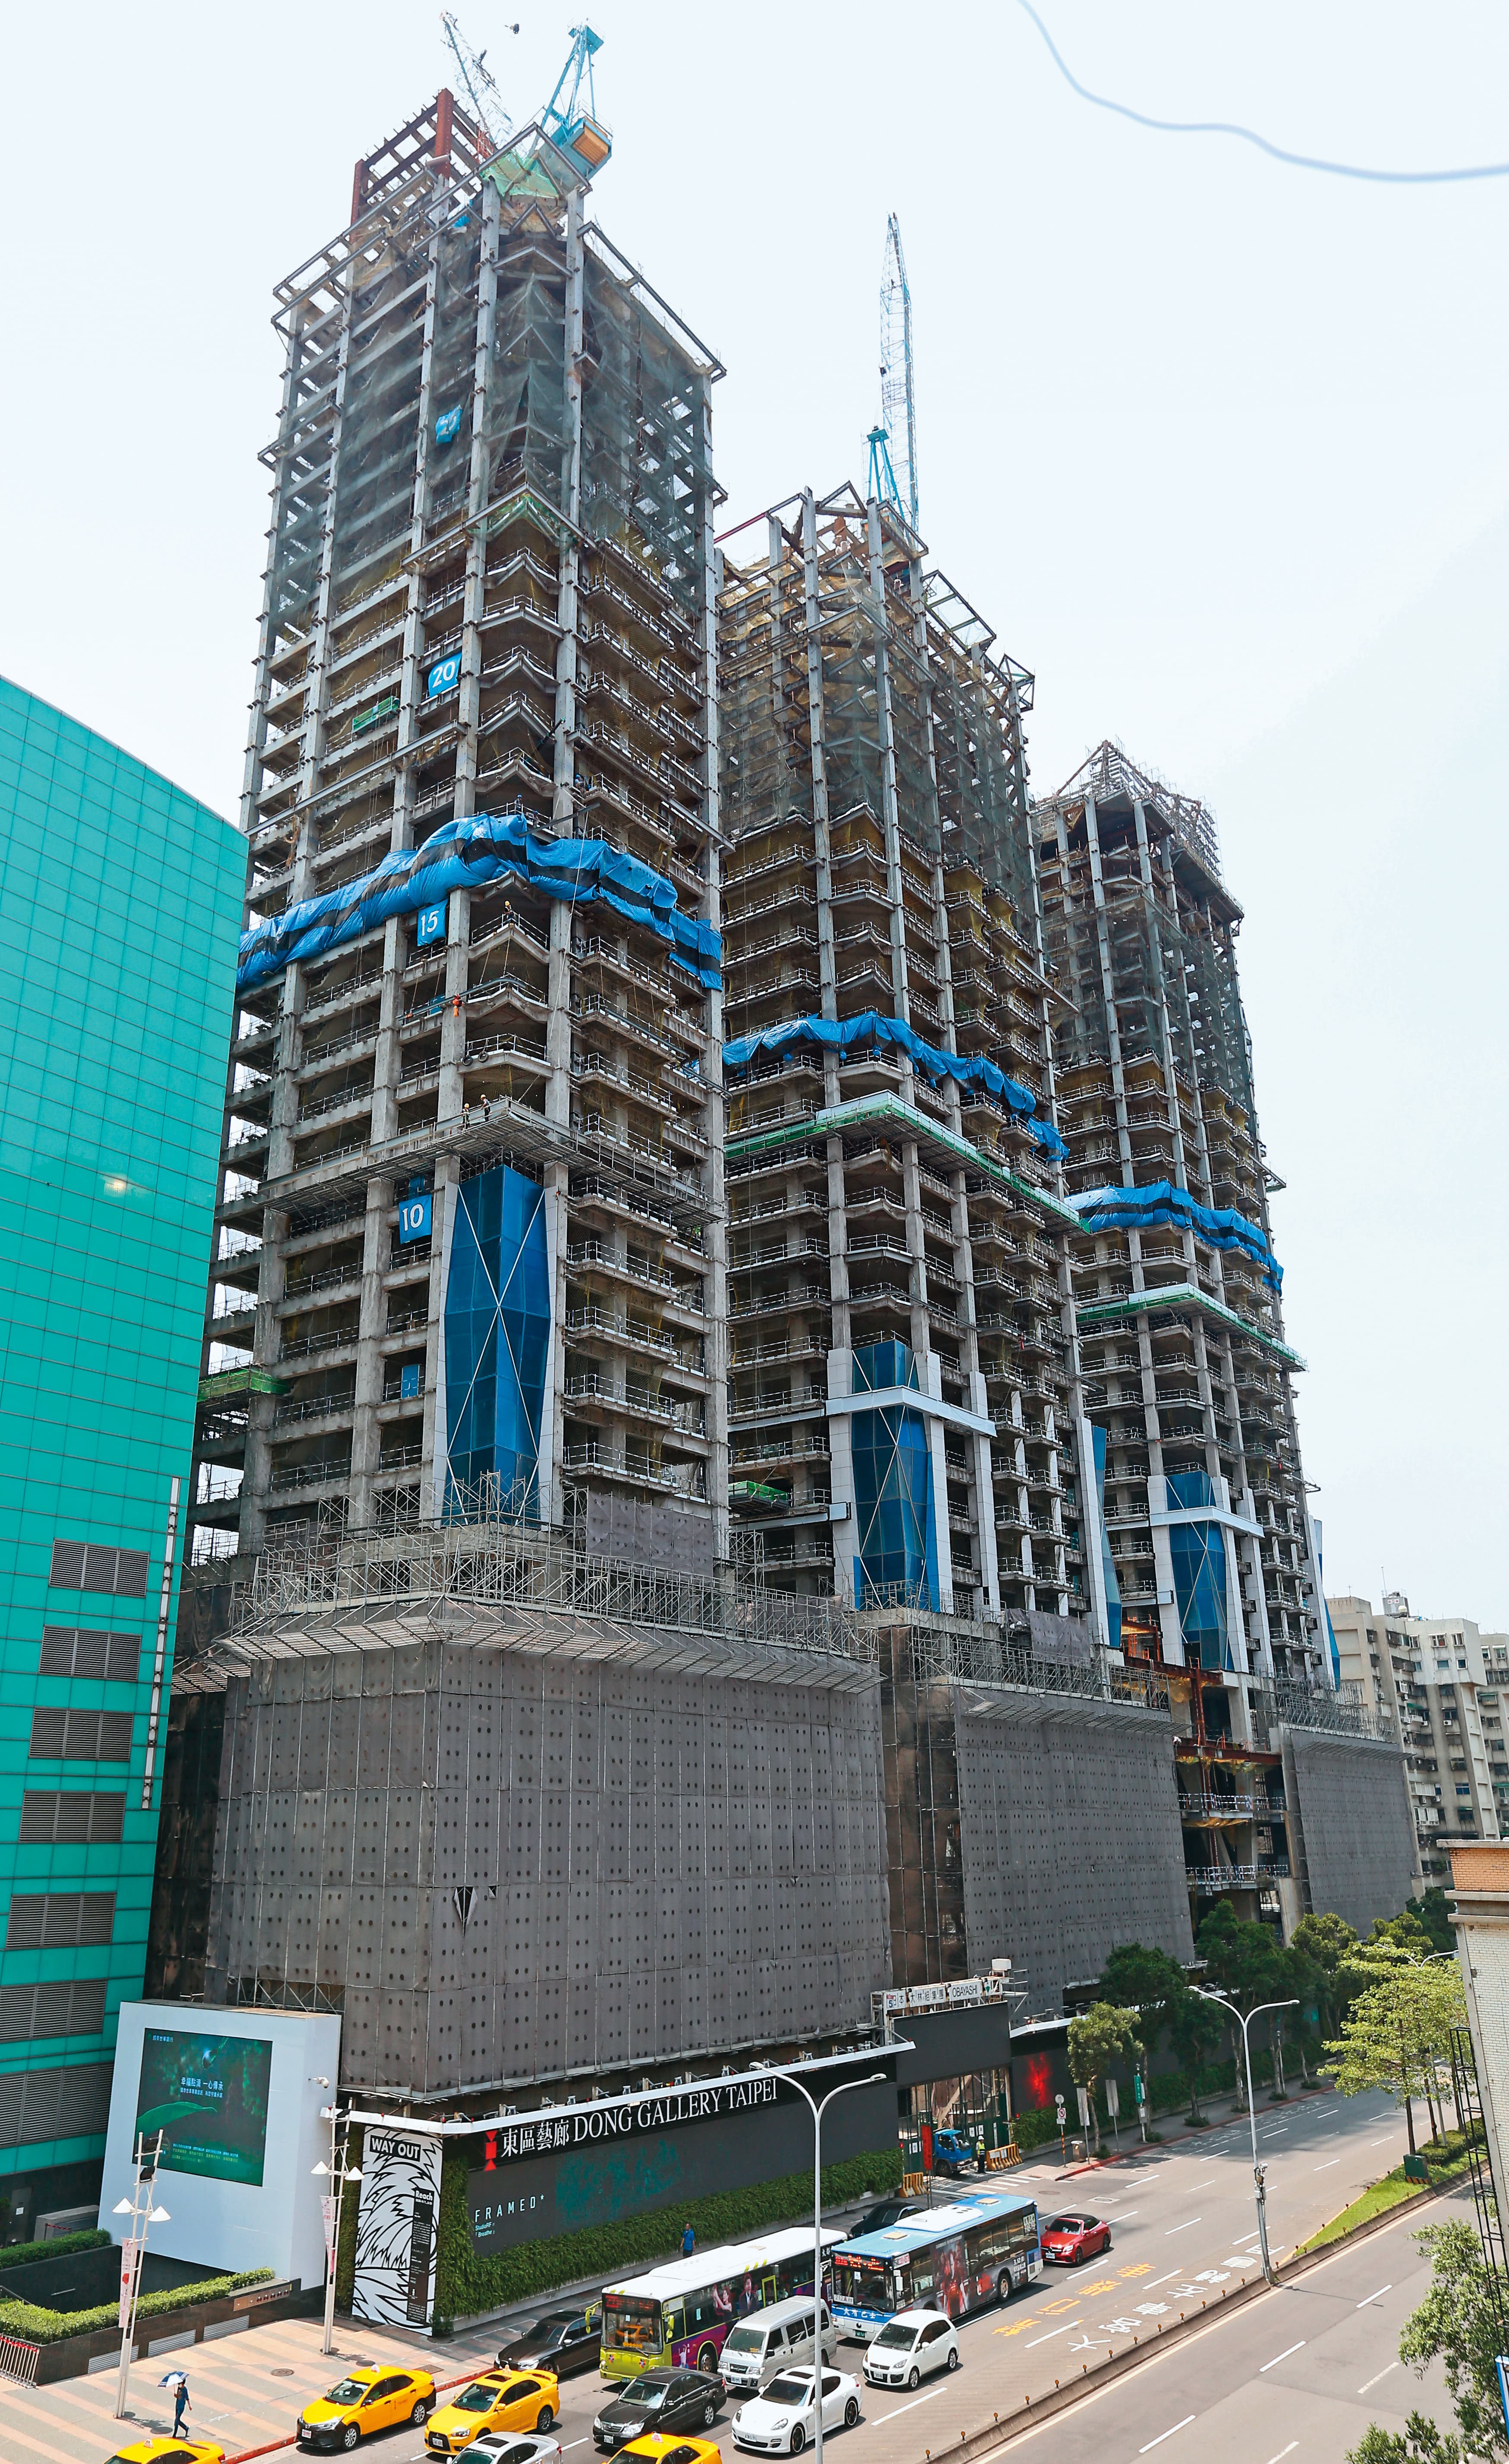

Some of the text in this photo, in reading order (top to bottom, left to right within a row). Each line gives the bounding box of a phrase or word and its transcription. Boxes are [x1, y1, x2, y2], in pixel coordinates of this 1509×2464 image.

[432, 661, 456, 688] 20
[421, 910, 440, 936] 15
[402, 1204, 424, 1231] 10
[952, 1985, 978, 1998] OBAYASHI
[889, 2000, 893, 2008] 5
[501, 2078, 777, 2157] 東區藝廊 DONG GALLERY TAIPEI
[371, 2138, 419, 2159] WAY OUT
[415, 2190, 433, 2201] Reach
[843, 2307, 876, 2319] 大有巴士
